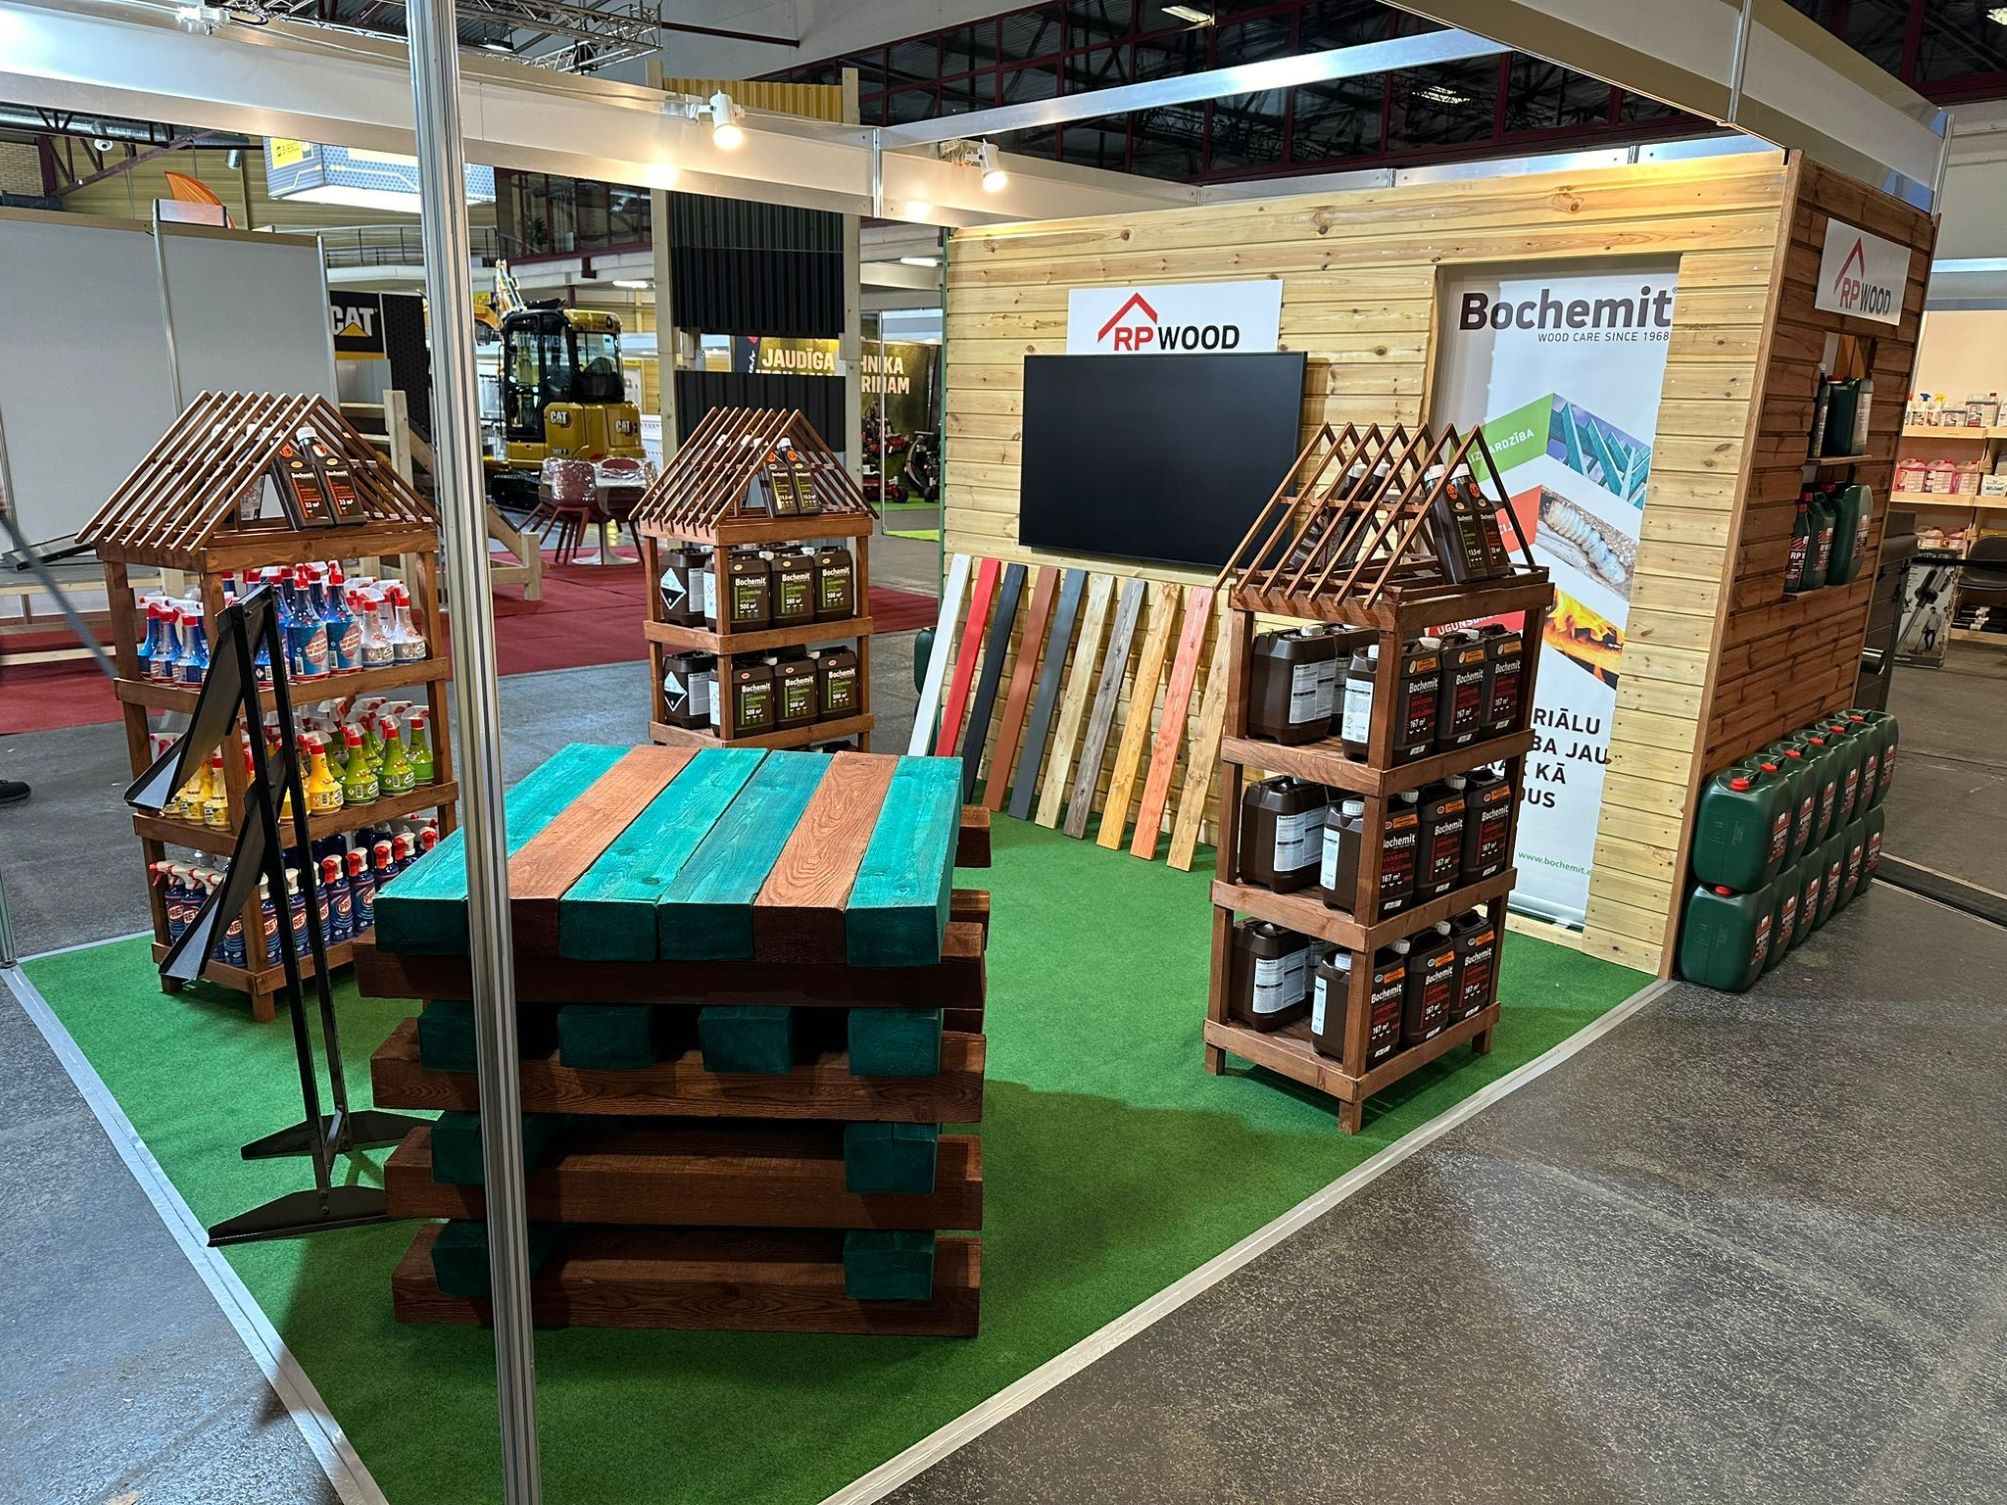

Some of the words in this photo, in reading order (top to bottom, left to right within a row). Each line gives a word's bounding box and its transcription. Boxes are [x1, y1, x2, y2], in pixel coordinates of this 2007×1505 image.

[1459, 286, 1672, 330] Bochemit
[330, 305, 374, 336] CAT
[1113, 326, 1154, 351] RP
[1158, 325, 1240, 351] WOOD
[1538, 333, 1569, 342] WOOD
[1573, 332, 1600, 342] CARE
[1604, 332, 1638, 341] SINCE
[1643, 332, 1669, 341] 1968
[762, 348, 835, 371] JAUDĪGA
[550, 411, 567, 424] CAT
[615, 420, 630, 433] CAT
[782, 573, 810, 581] Bochemit
[822, 567, 850, 576] Bochemit
[735, 577, 766, 586] Bochemit
[828, 668, 855, 678] Bochemit
[1495, 660, 1520, 673] Bochemit
[785, 676, 814, 686] Bochemit
[1456, 669, 1483, 685] Bochemit
[741, 683, 771, 693] Bochemit
[1409, 679, 1438, 693] Bochemit
[1565, 741, 1609, 764] JAU
[1535, 762, 1566, 784] KĀ
[1482, 805, 1509, 822] Bochemit
[1435, 819, 1463, 836] Bochemit
[1465, 947, 1492, 966] Bochemit
[1425, 966, 1453, 985] Bochemit
[1371, 983, 1402, 1004] Bochemit
